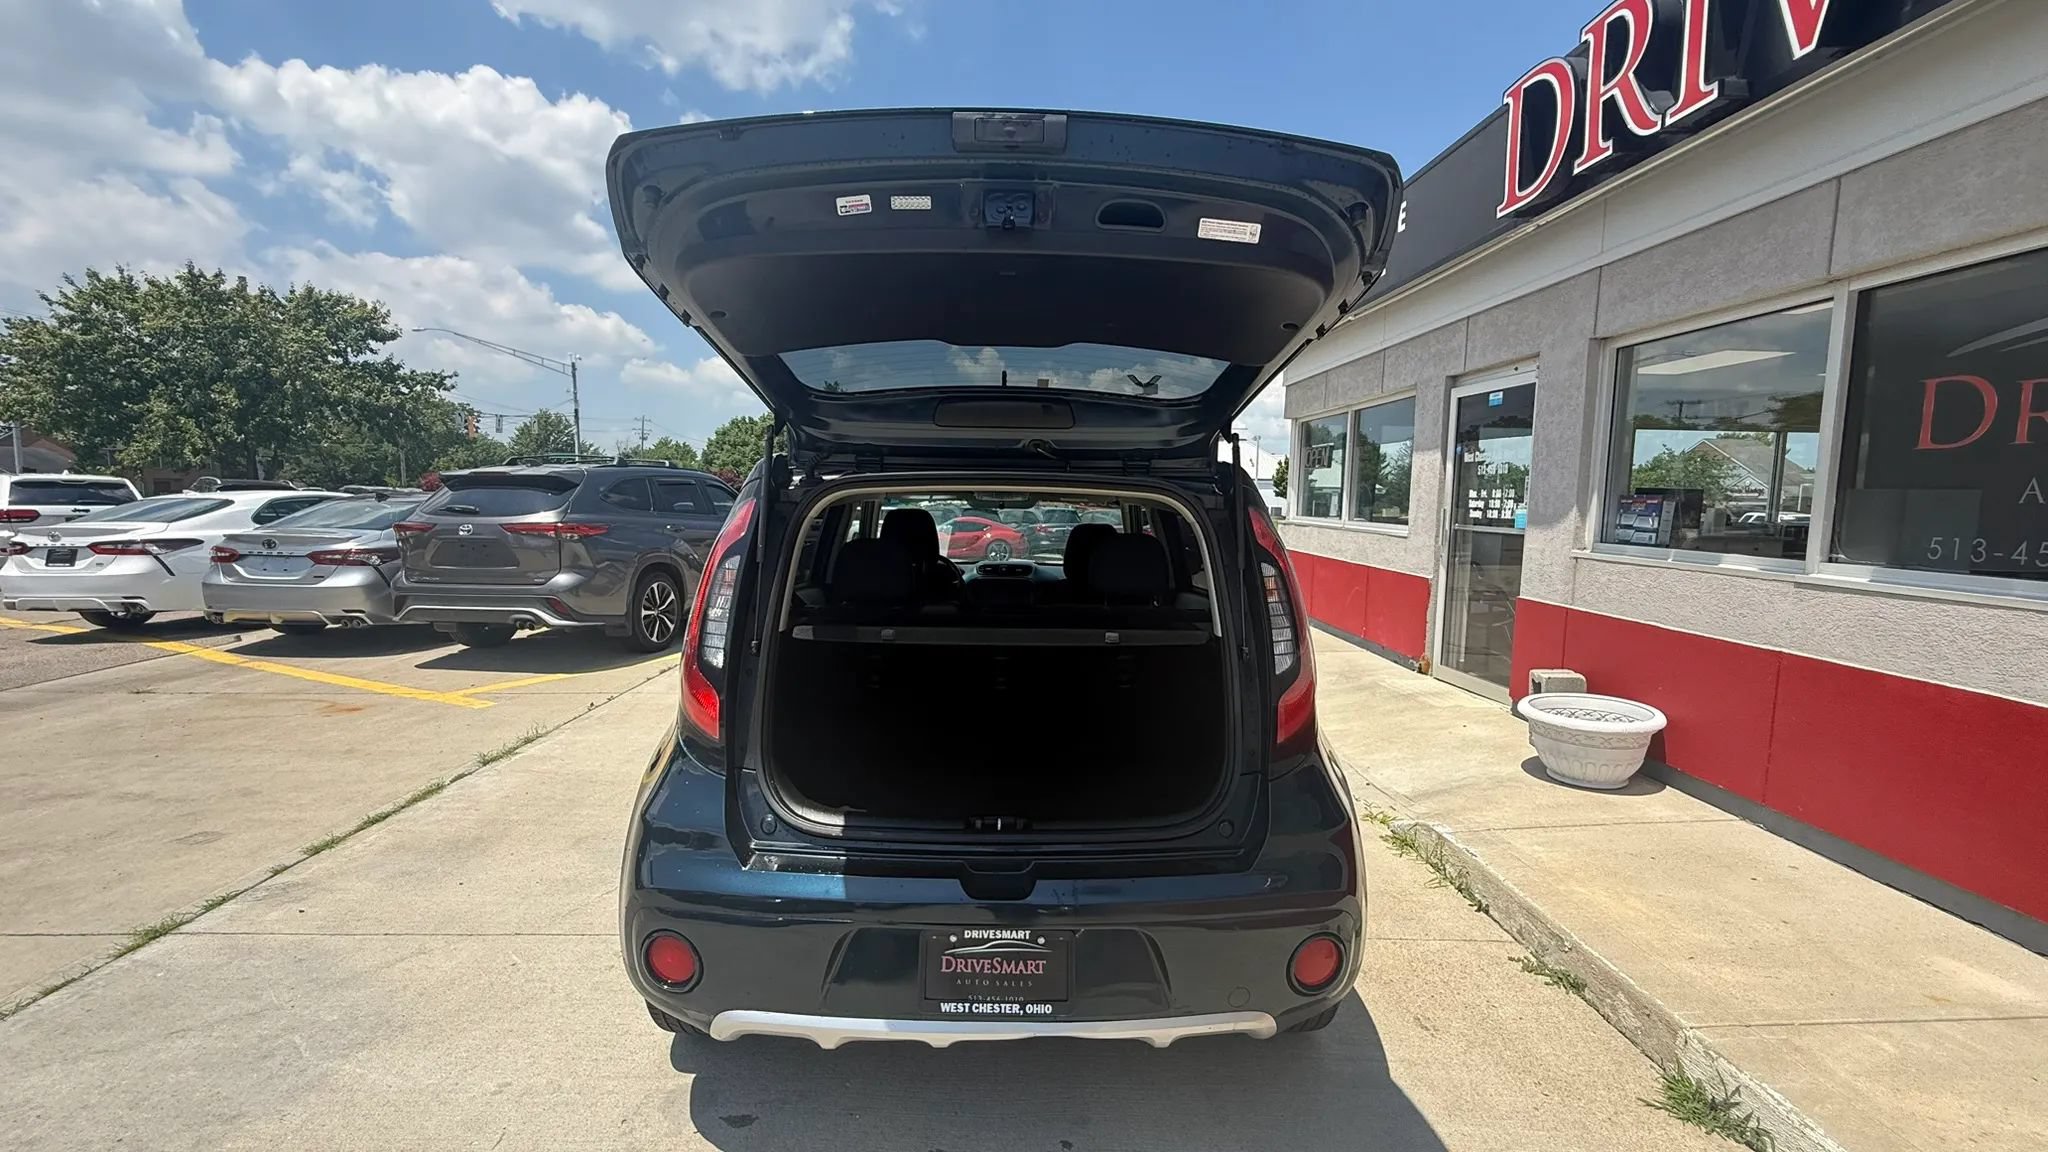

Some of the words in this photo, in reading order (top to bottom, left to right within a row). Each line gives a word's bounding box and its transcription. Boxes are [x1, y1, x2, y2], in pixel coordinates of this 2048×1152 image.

[964, 930, 1031, 940] DRIVESMART
[956, 978, 990, 986] AUTO
[940, 1002, 970, 1013] WEST
[971, 1003, 1024, 1015] CHESTER,
[1025, 1004, 1053, 1014] OHIO
